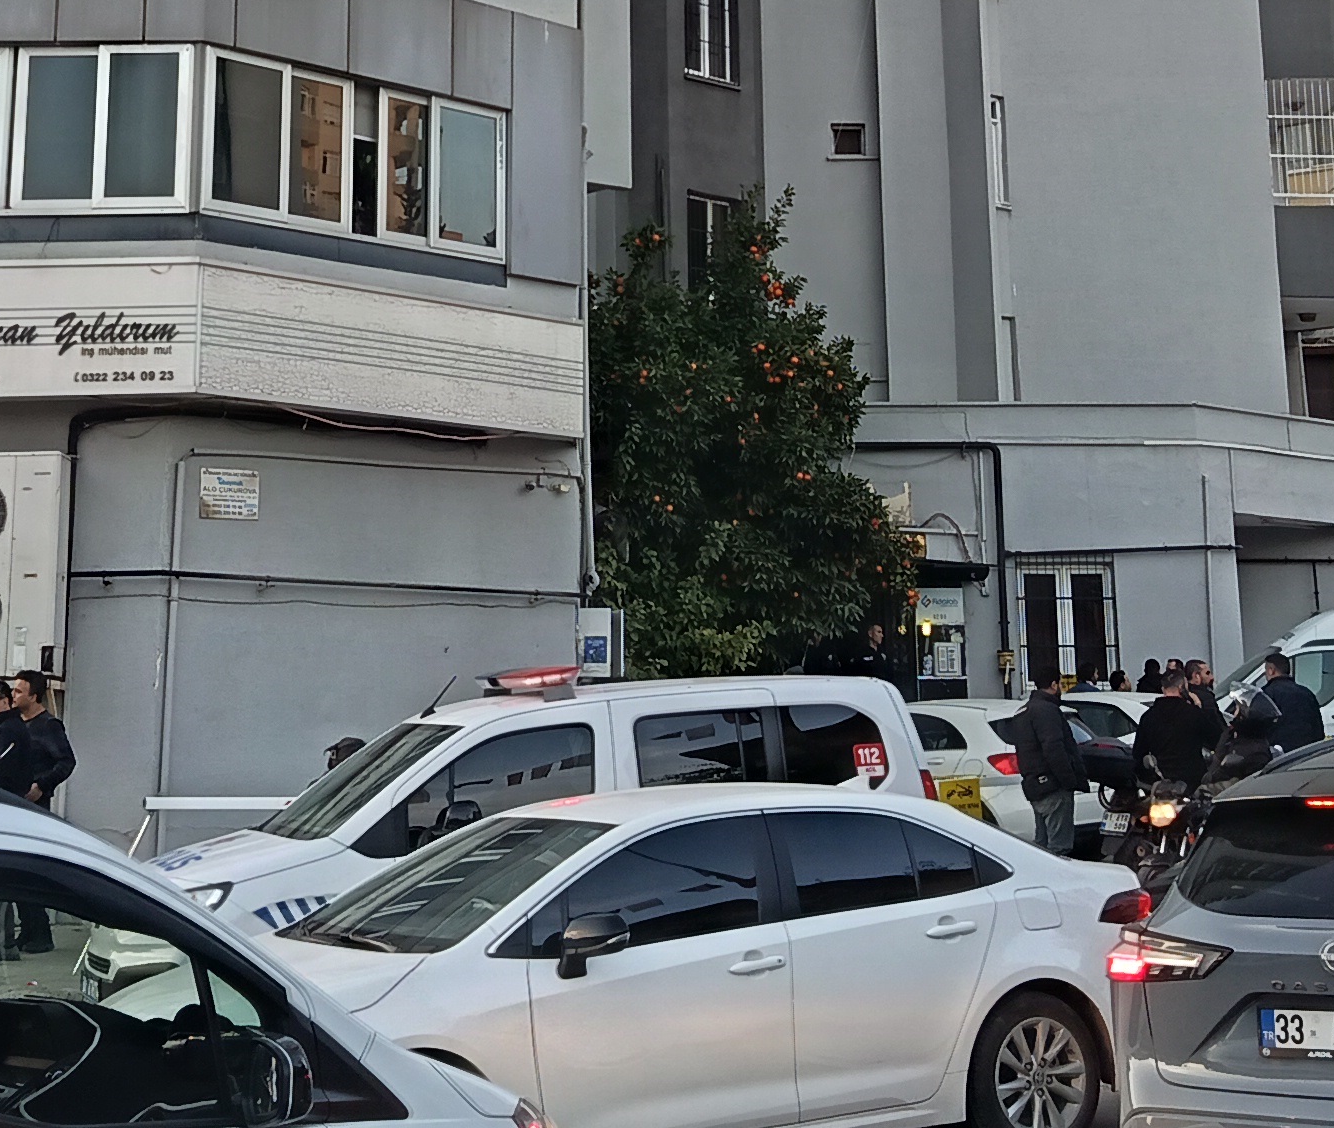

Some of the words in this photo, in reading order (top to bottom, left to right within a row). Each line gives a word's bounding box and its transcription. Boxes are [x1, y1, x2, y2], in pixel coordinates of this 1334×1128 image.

[55, 311, 180, 356] Yıldırım
[81, 372, 108, 383] 0322
[112, 371, 135, 382] 234
[141, 370, 156, 381] 09
[159, 370, 174, 381] 23
[857, 747, 881, 765] 112
[1262, 1030, 1275, 1040] TR
[1275, 1014, 1305, 1045] 33
